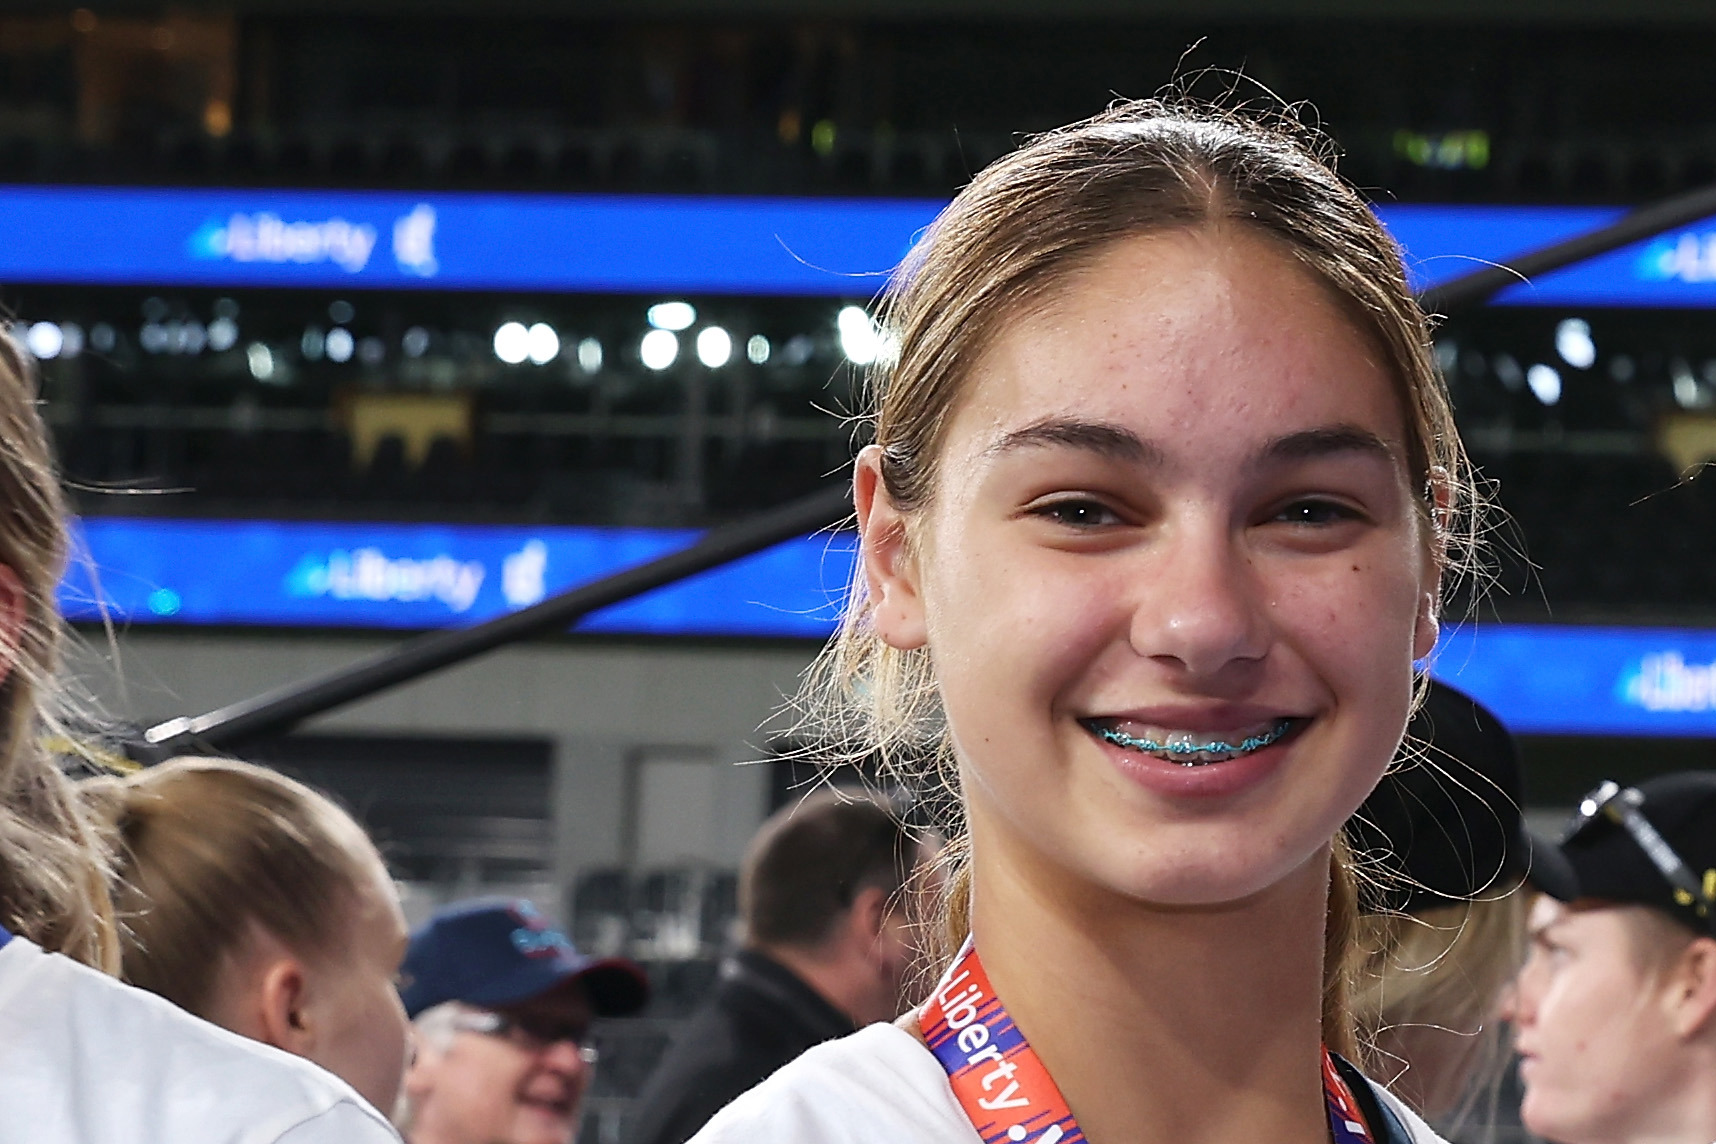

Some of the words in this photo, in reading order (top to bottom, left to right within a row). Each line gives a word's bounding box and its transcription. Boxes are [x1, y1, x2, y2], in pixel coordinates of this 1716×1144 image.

[228, 212, 377, 274] Liberty
[329, 548, 486, 613] Liberty
[937, 969, 1030, 1111] Liberty
